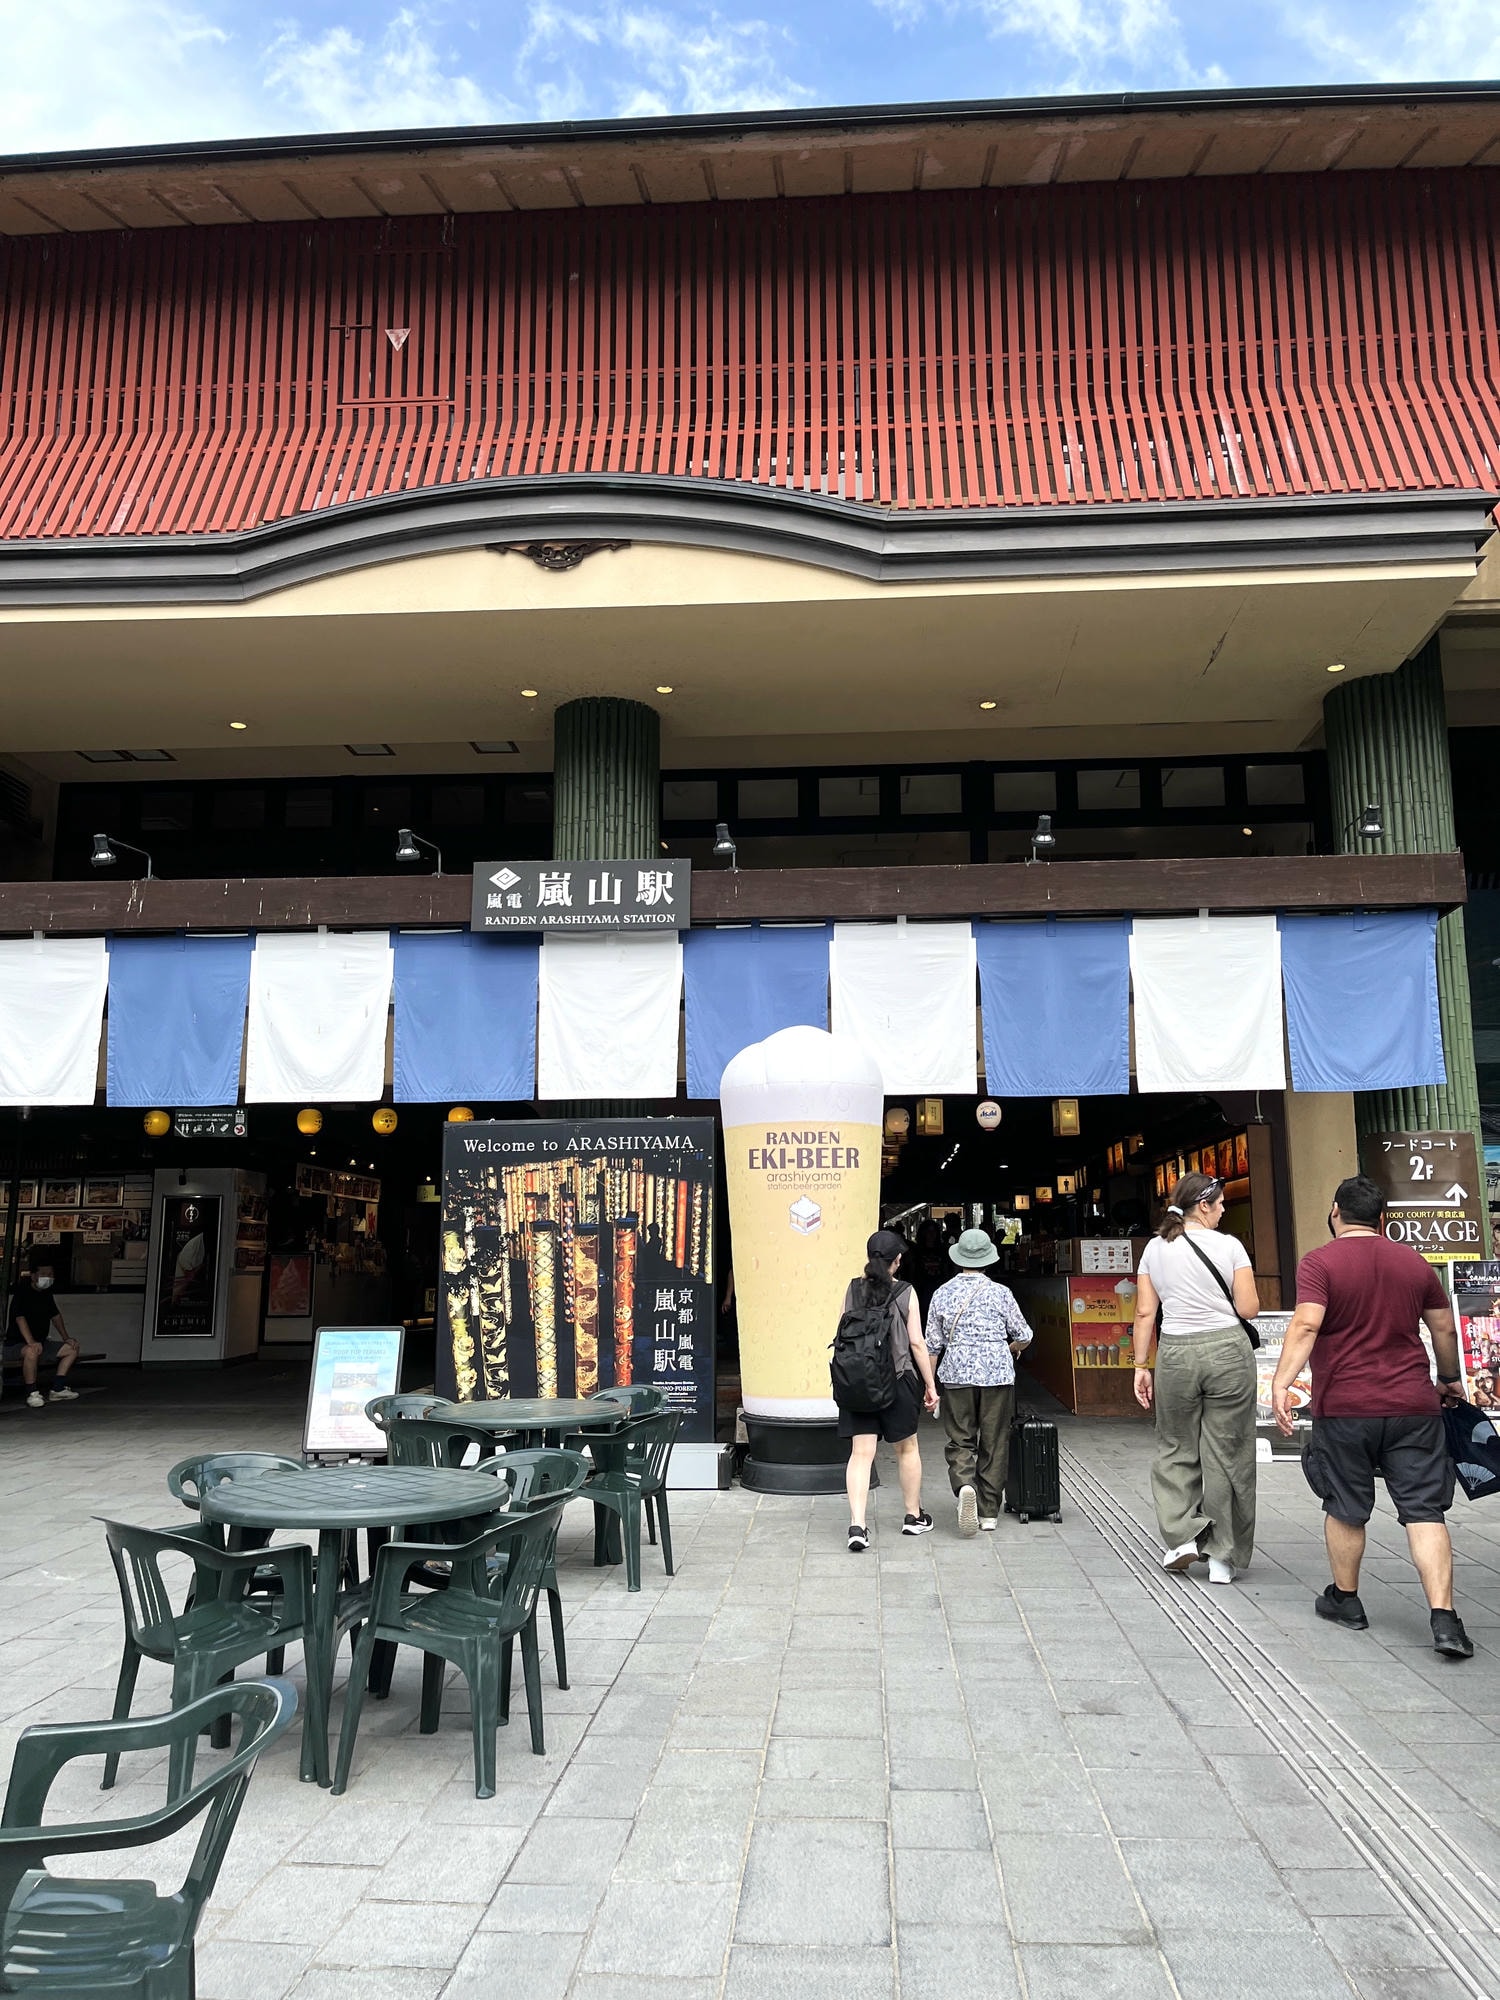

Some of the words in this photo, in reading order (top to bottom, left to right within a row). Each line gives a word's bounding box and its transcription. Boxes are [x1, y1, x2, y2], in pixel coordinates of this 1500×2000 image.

[536, 870, 674, 907] 嵐山駅
[486, 892, 523, 909] 嵐電
[485, 915, 538, 925] RANDEN
[540, 914, 621, 925] ARASHIYAMA
[623, 913, 676, 924] STATION
[463, 1138, 536, 1153] Welcome
[543, 1139, 559, 1152] to
[566, 1135, 695, 1152] ARASHIYAMA
[766, 1131, 840, 1145] RANDEN
[1382, 1138, 1457, 1152] フードコート
[748, 1147, 860, 1170] EKI-BEER
[1409, 1155, 1434, 1180] 2F
[767, 1170, 842, 1183] arashiyama
[767, 1182, 792, 1190] station
[793, 1182, 813, 1190] beer
[813, 1182, 842, 1191] garden
[1385, 1220, 1480, 1242] ORAGE
[678, 1288, 694, 1323] 京都
[653, 1288, 677, 1373] 嵐山駅
[678, 1334, 694, 1371] 嵐電
